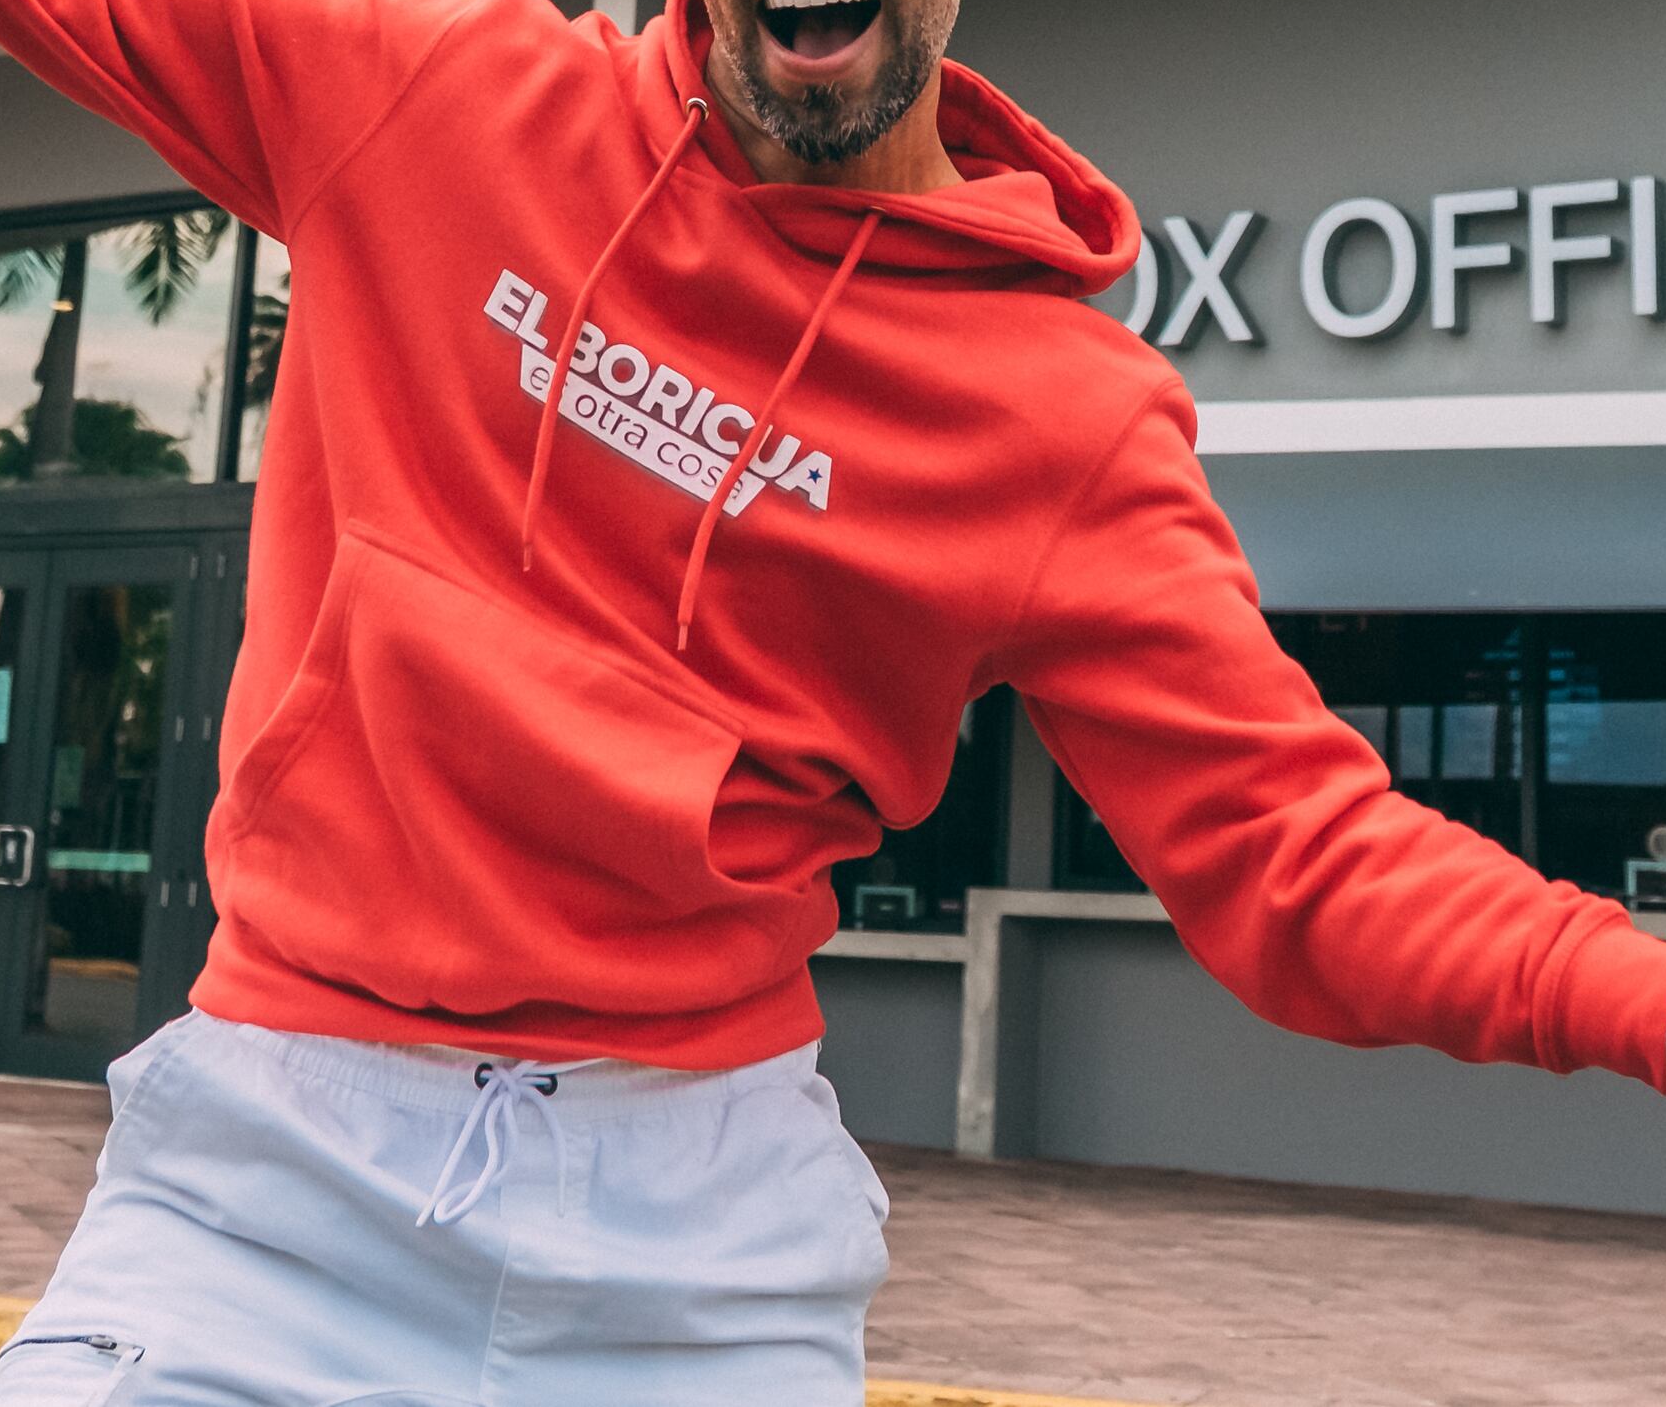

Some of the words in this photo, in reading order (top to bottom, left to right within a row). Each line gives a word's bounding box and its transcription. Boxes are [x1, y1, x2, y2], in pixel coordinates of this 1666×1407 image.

[483, 268, 548, 351] EL
[568, 320, 833, 512] BORICUA
[574, 394, 649, 451] otra
